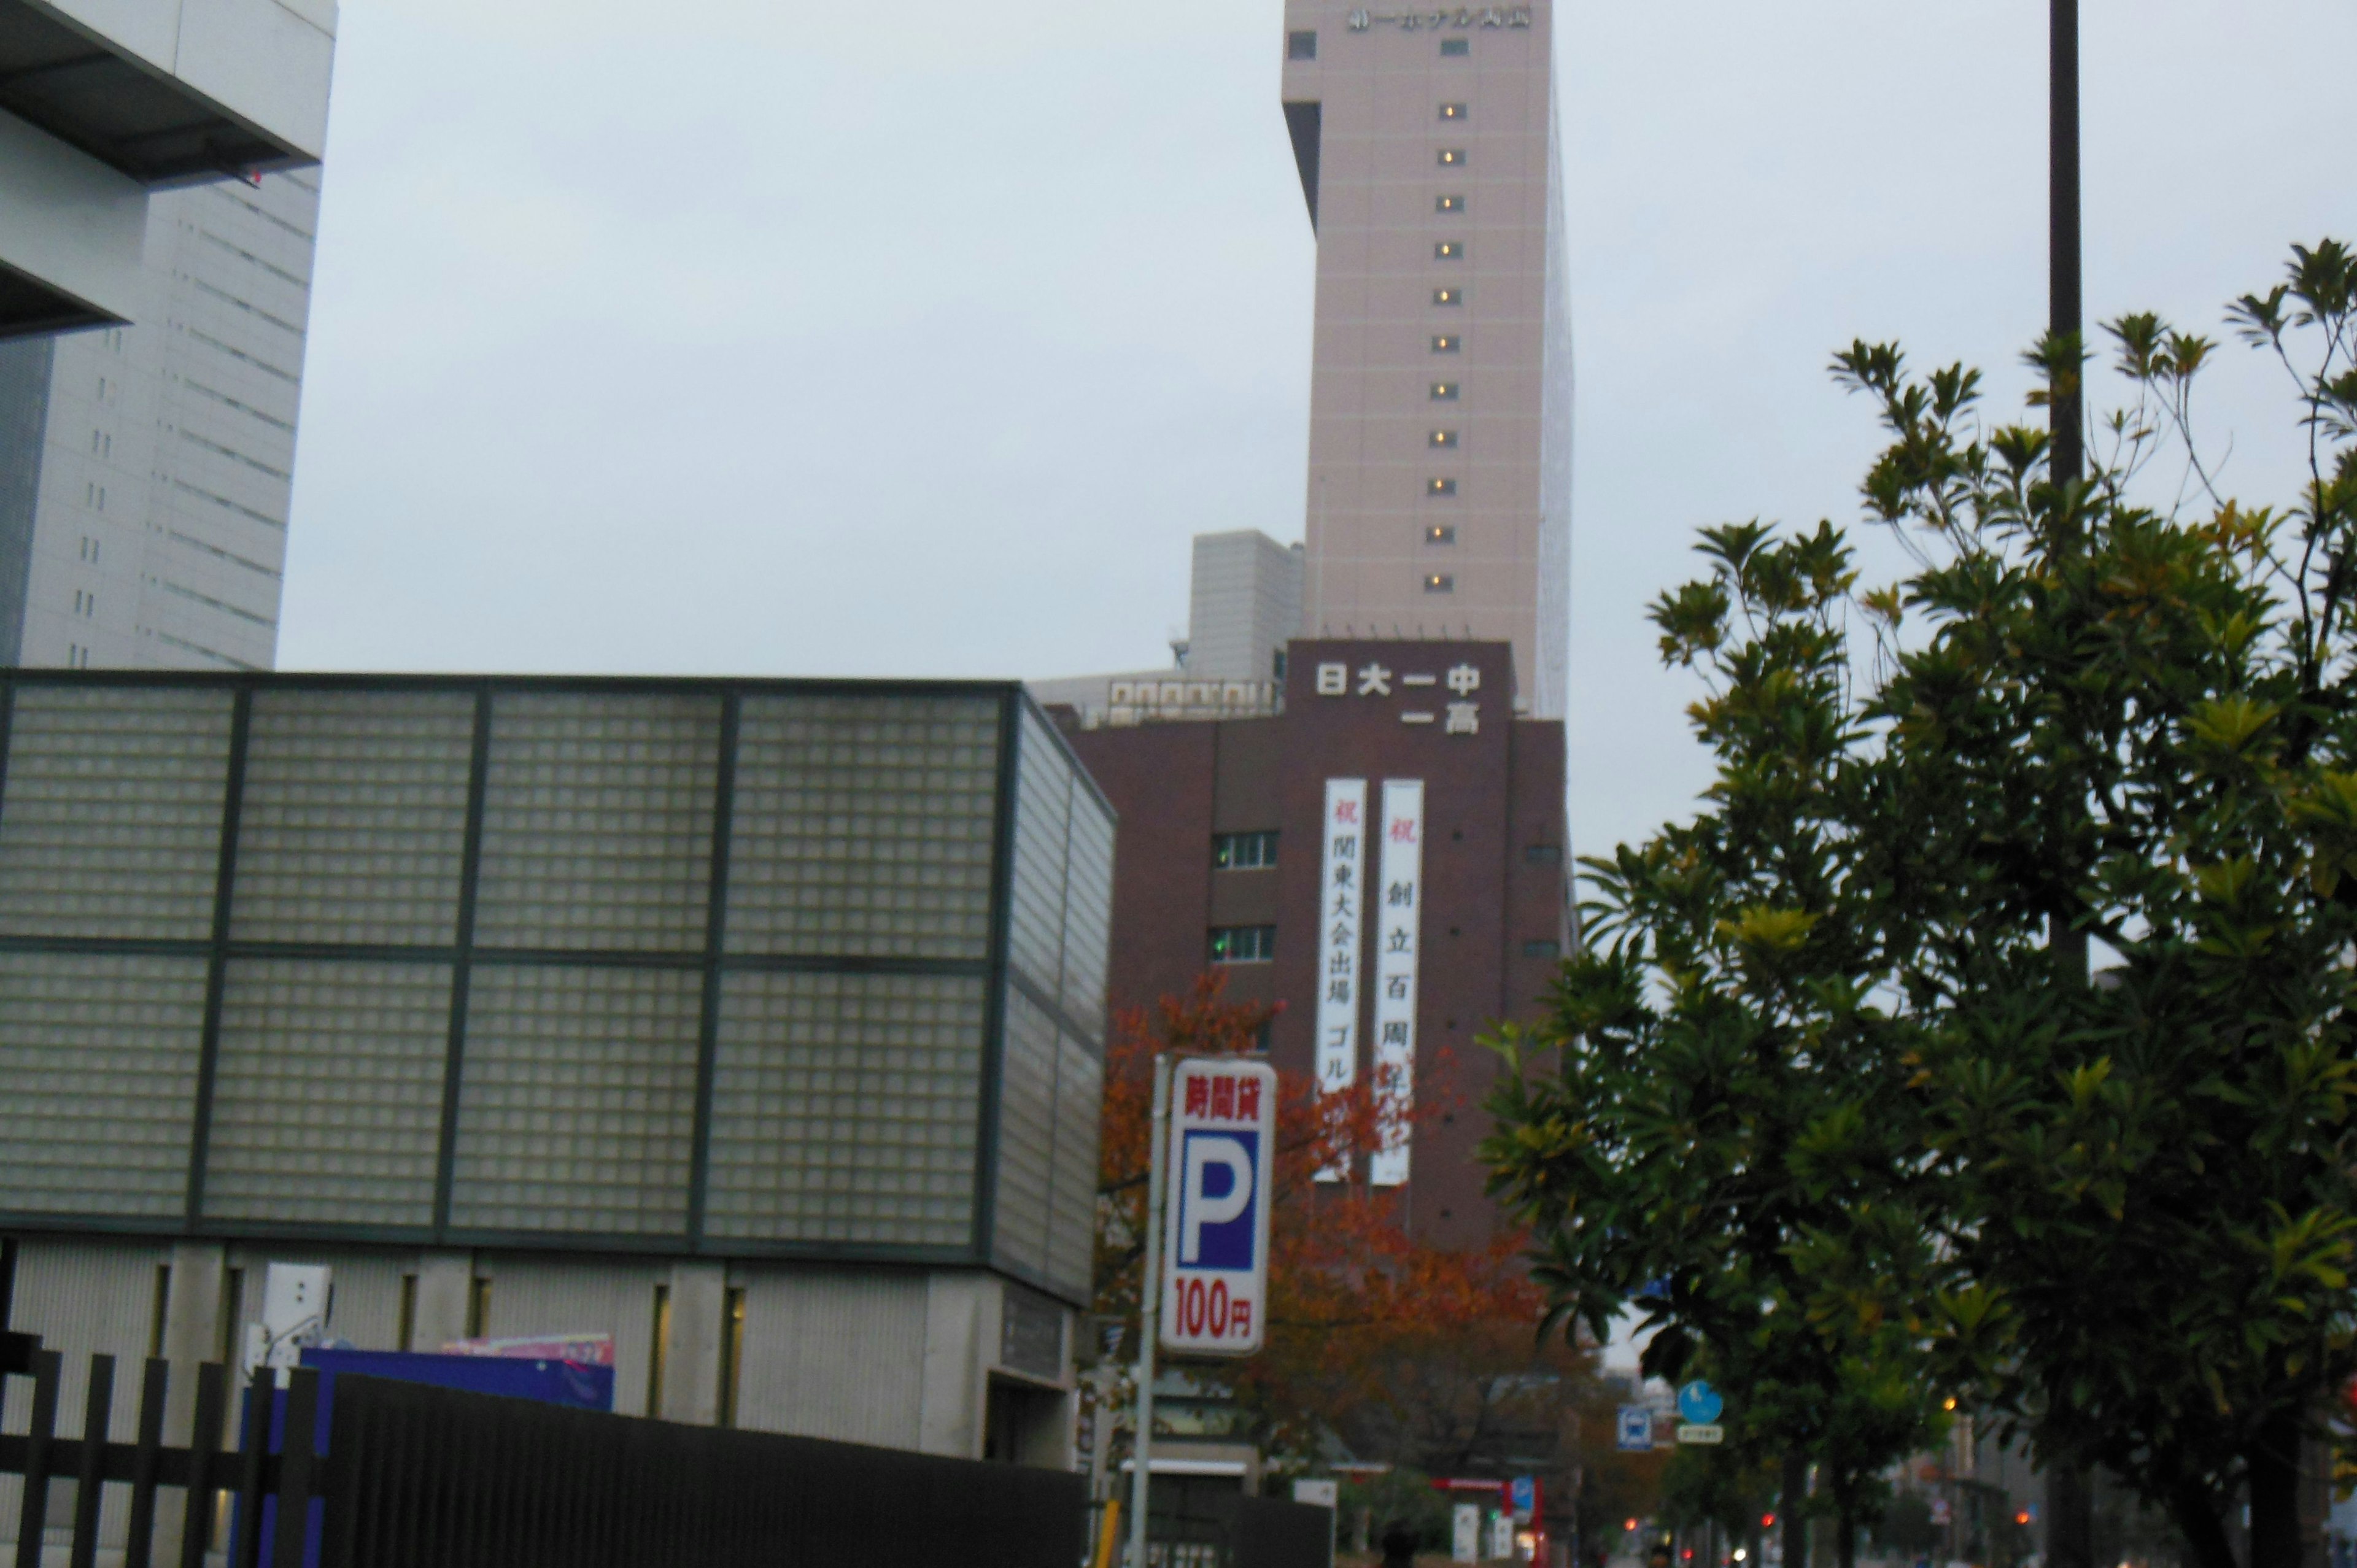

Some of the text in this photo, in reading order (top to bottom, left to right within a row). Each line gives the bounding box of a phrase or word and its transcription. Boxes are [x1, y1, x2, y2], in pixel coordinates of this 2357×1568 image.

[1317, 662, 1480, 697] 日大一中
[1401, 702, 1479, 735] 一高
[1185, 1075, 1260, 1121] 時間貸
[1182, 1136, 1252, 1262] P
[1175, 1277, 1252, 1337] 100円
